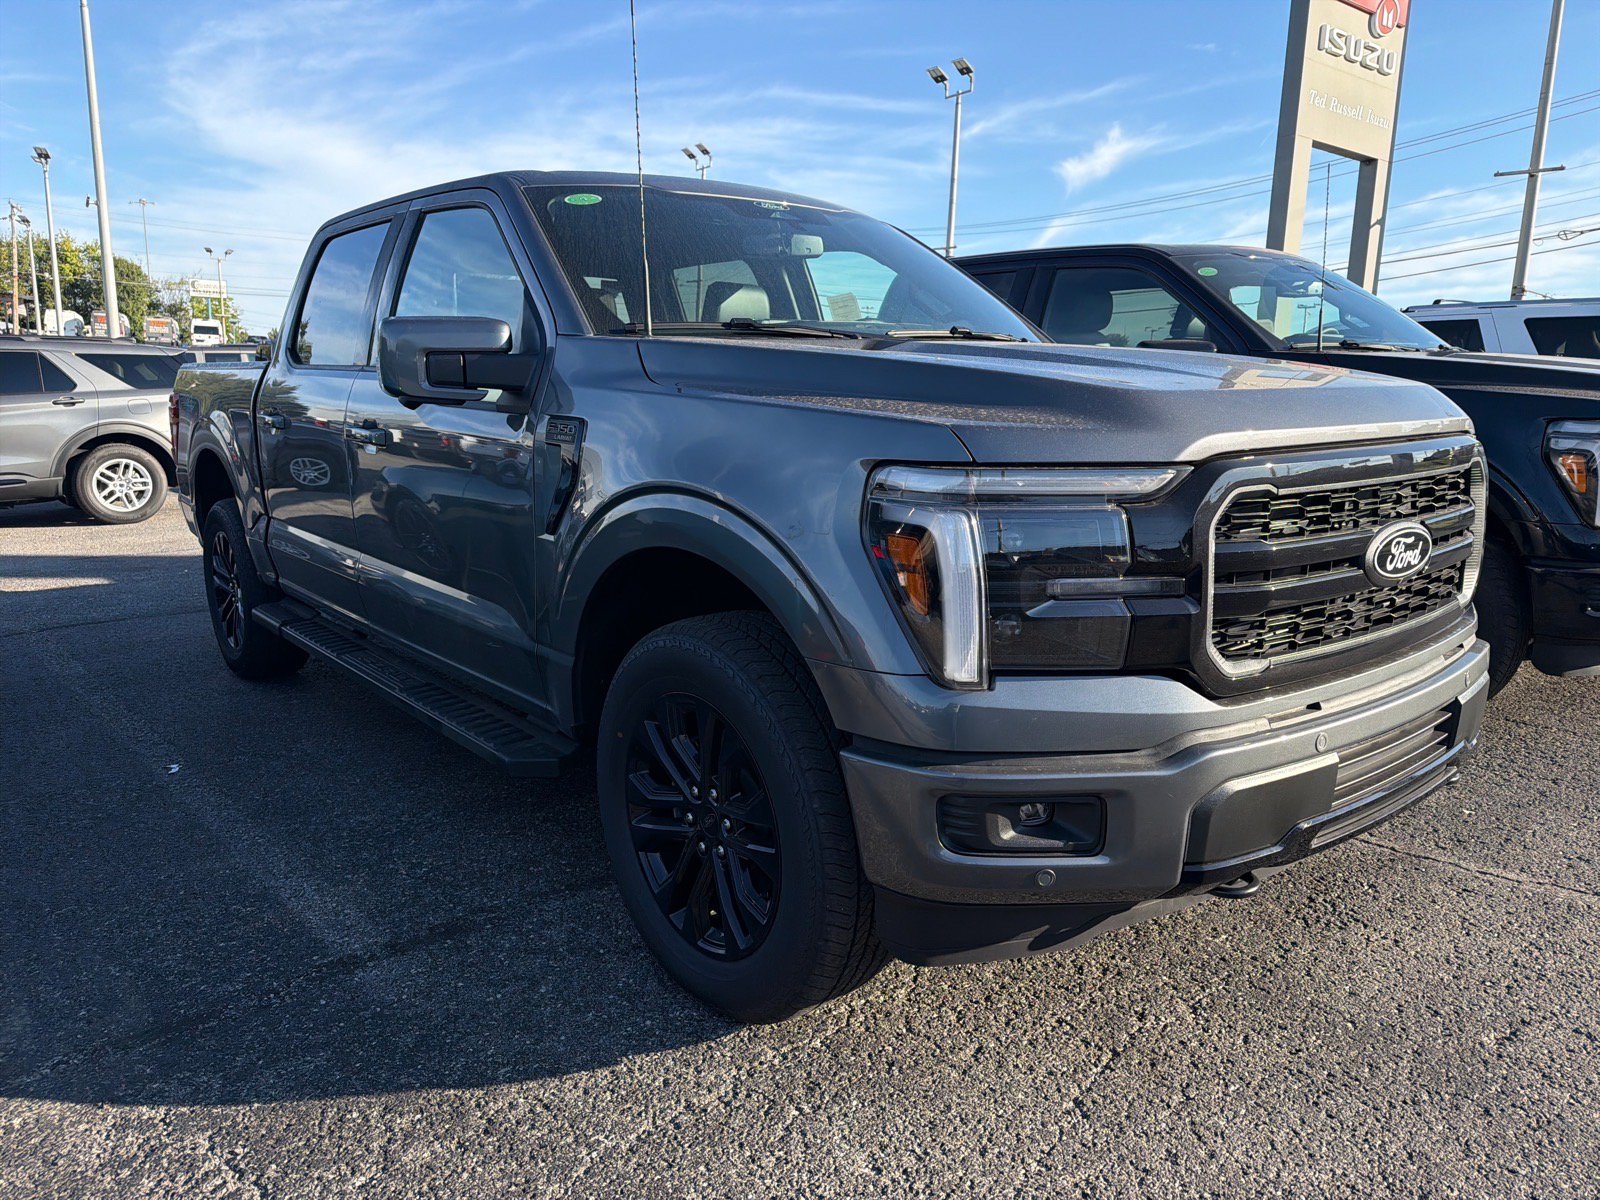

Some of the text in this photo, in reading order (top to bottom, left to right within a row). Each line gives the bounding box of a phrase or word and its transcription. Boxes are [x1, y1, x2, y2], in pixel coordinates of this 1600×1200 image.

[1318, 23, 1398, 75] ISUZU
[1309, 89, 1390, 129] Ted Russell Isuzu
[1386, 535, 1424, 571] Ford
